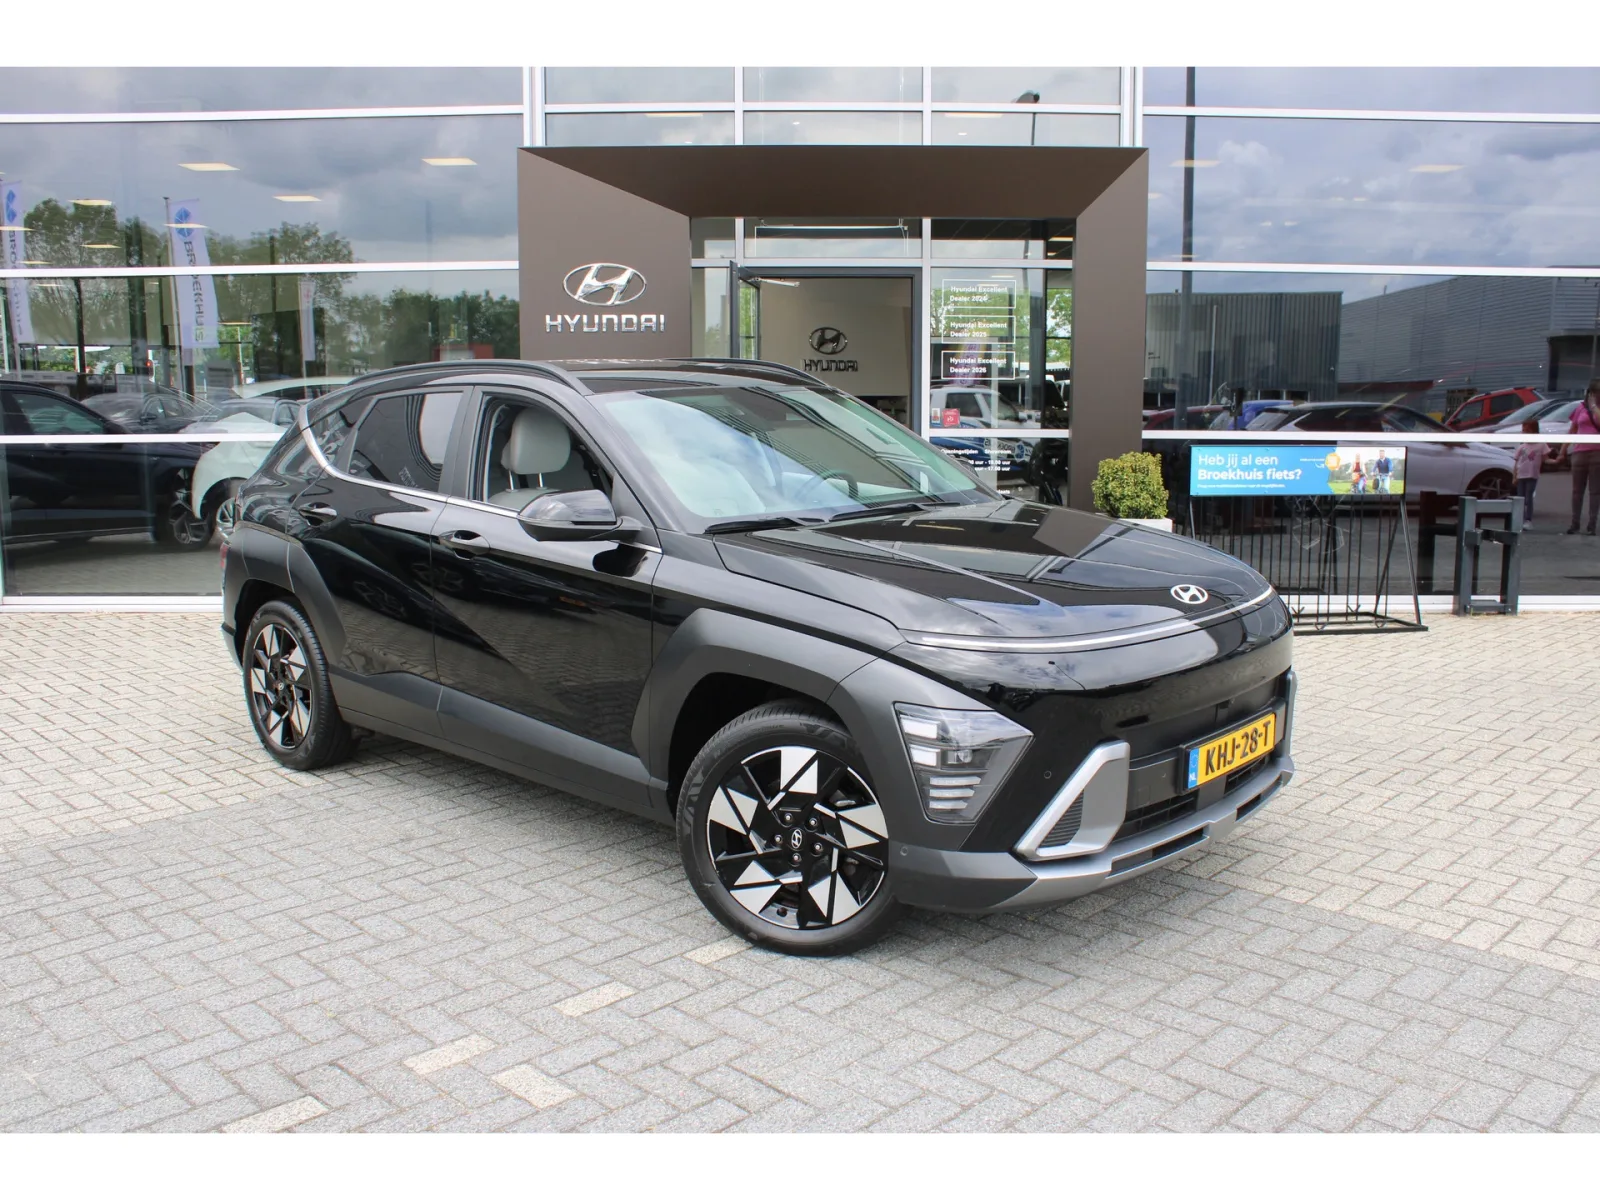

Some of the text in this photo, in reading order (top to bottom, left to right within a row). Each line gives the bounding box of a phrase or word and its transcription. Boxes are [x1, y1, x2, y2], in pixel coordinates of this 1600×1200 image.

[184, 240, 205, 342] BREKHUIS
[545, 314, 665, 332] HYUNDAI
[950, 321, 1008, 329] Hyundai Excellent
[803, 359, 858, 372] HYUNDAI
[949, 357, 976, 365] Hyundai
[1198, 454, 1279, 468] Heb jij al een
[1198, 468, 1302, 481] Broekhuis fiets?
[1204, 720, 1271, 776] KHJ-28-T
[1189, 772, 1197, 782] NL
